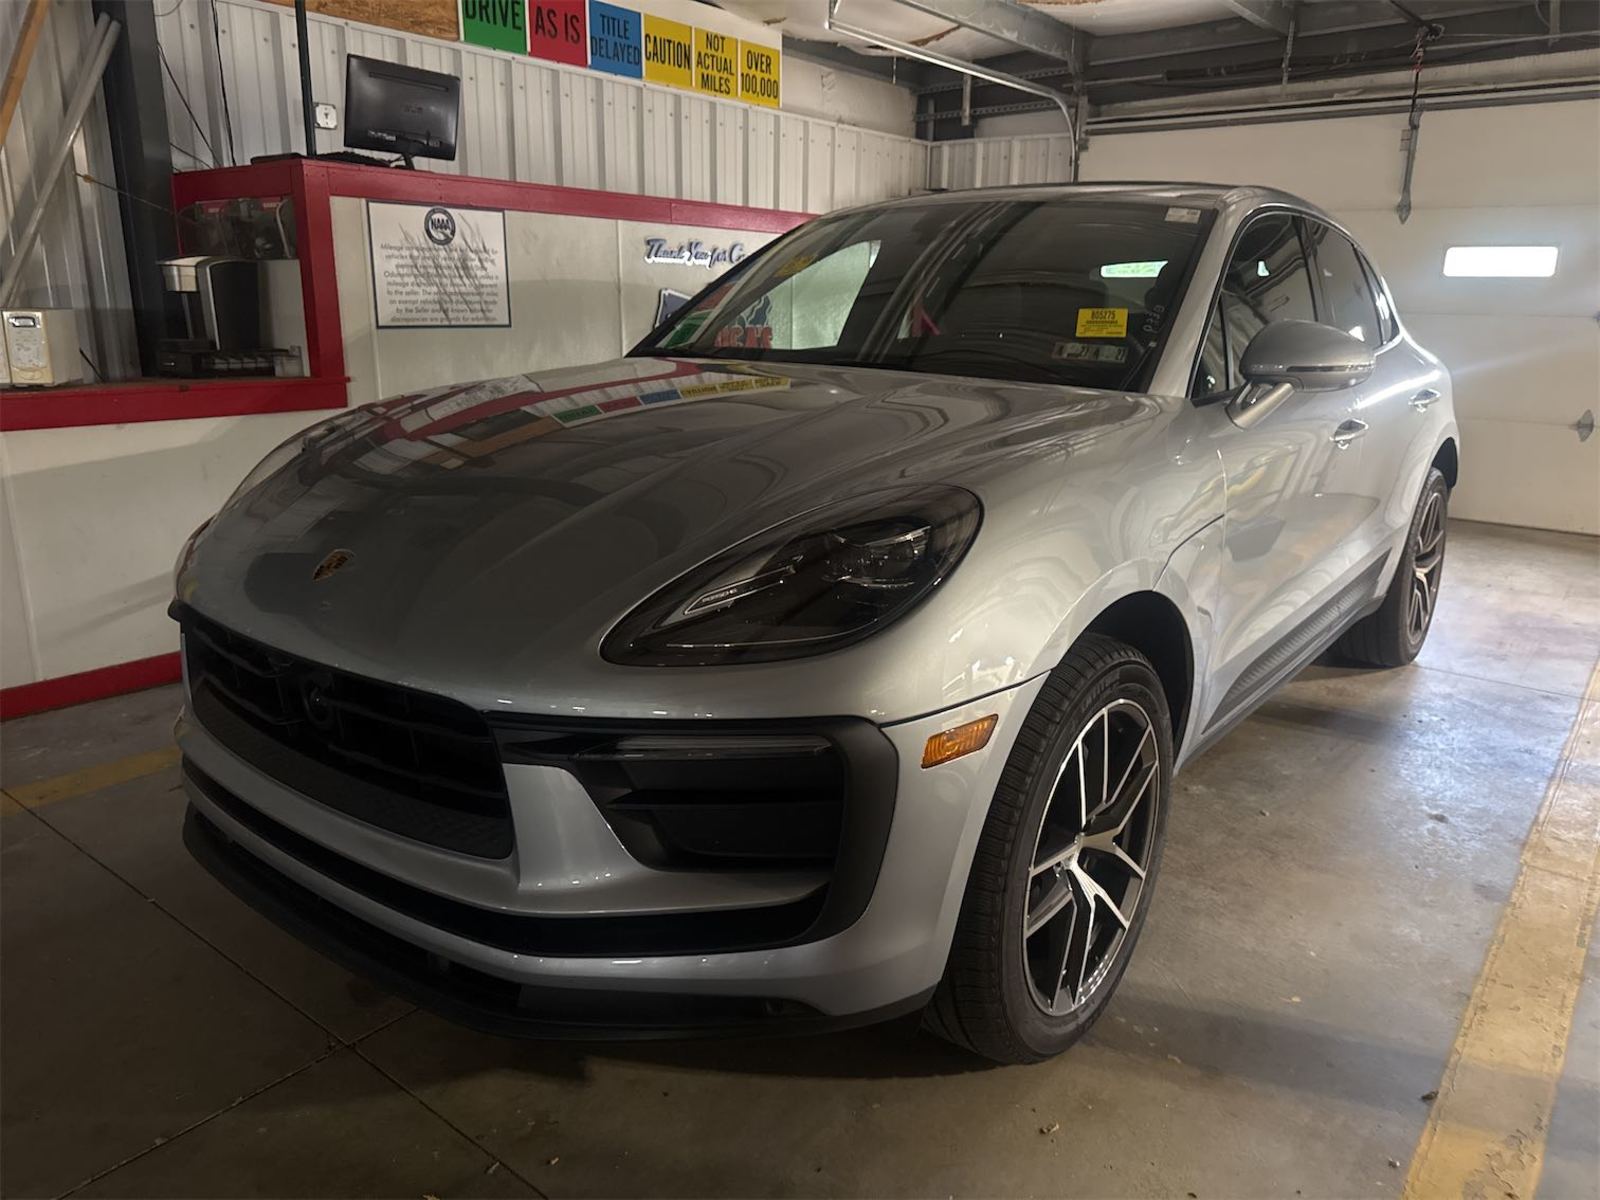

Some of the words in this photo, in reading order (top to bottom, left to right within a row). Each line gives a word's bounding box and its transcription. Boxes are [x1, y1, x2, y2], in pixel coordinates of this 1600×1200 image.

[535, 6, 558, 39] AS
[564, 13, 580, 44] IS
[600, 14, 630, 40] TITLE
[590, 35, 640, 66] DELAYED
[644, 33, 691, 70] CAUTION
[706, 32, 726, 53] NOT
[696, 53, 735, 76] ACTUAL
[746, 50, 772, 75] OVER
[701, 73, 731, 95] MILES
[740, 73, 778, 100] 100,000
[645, 238, 685, 261] Thank
[688, 240, 710, 262] You
